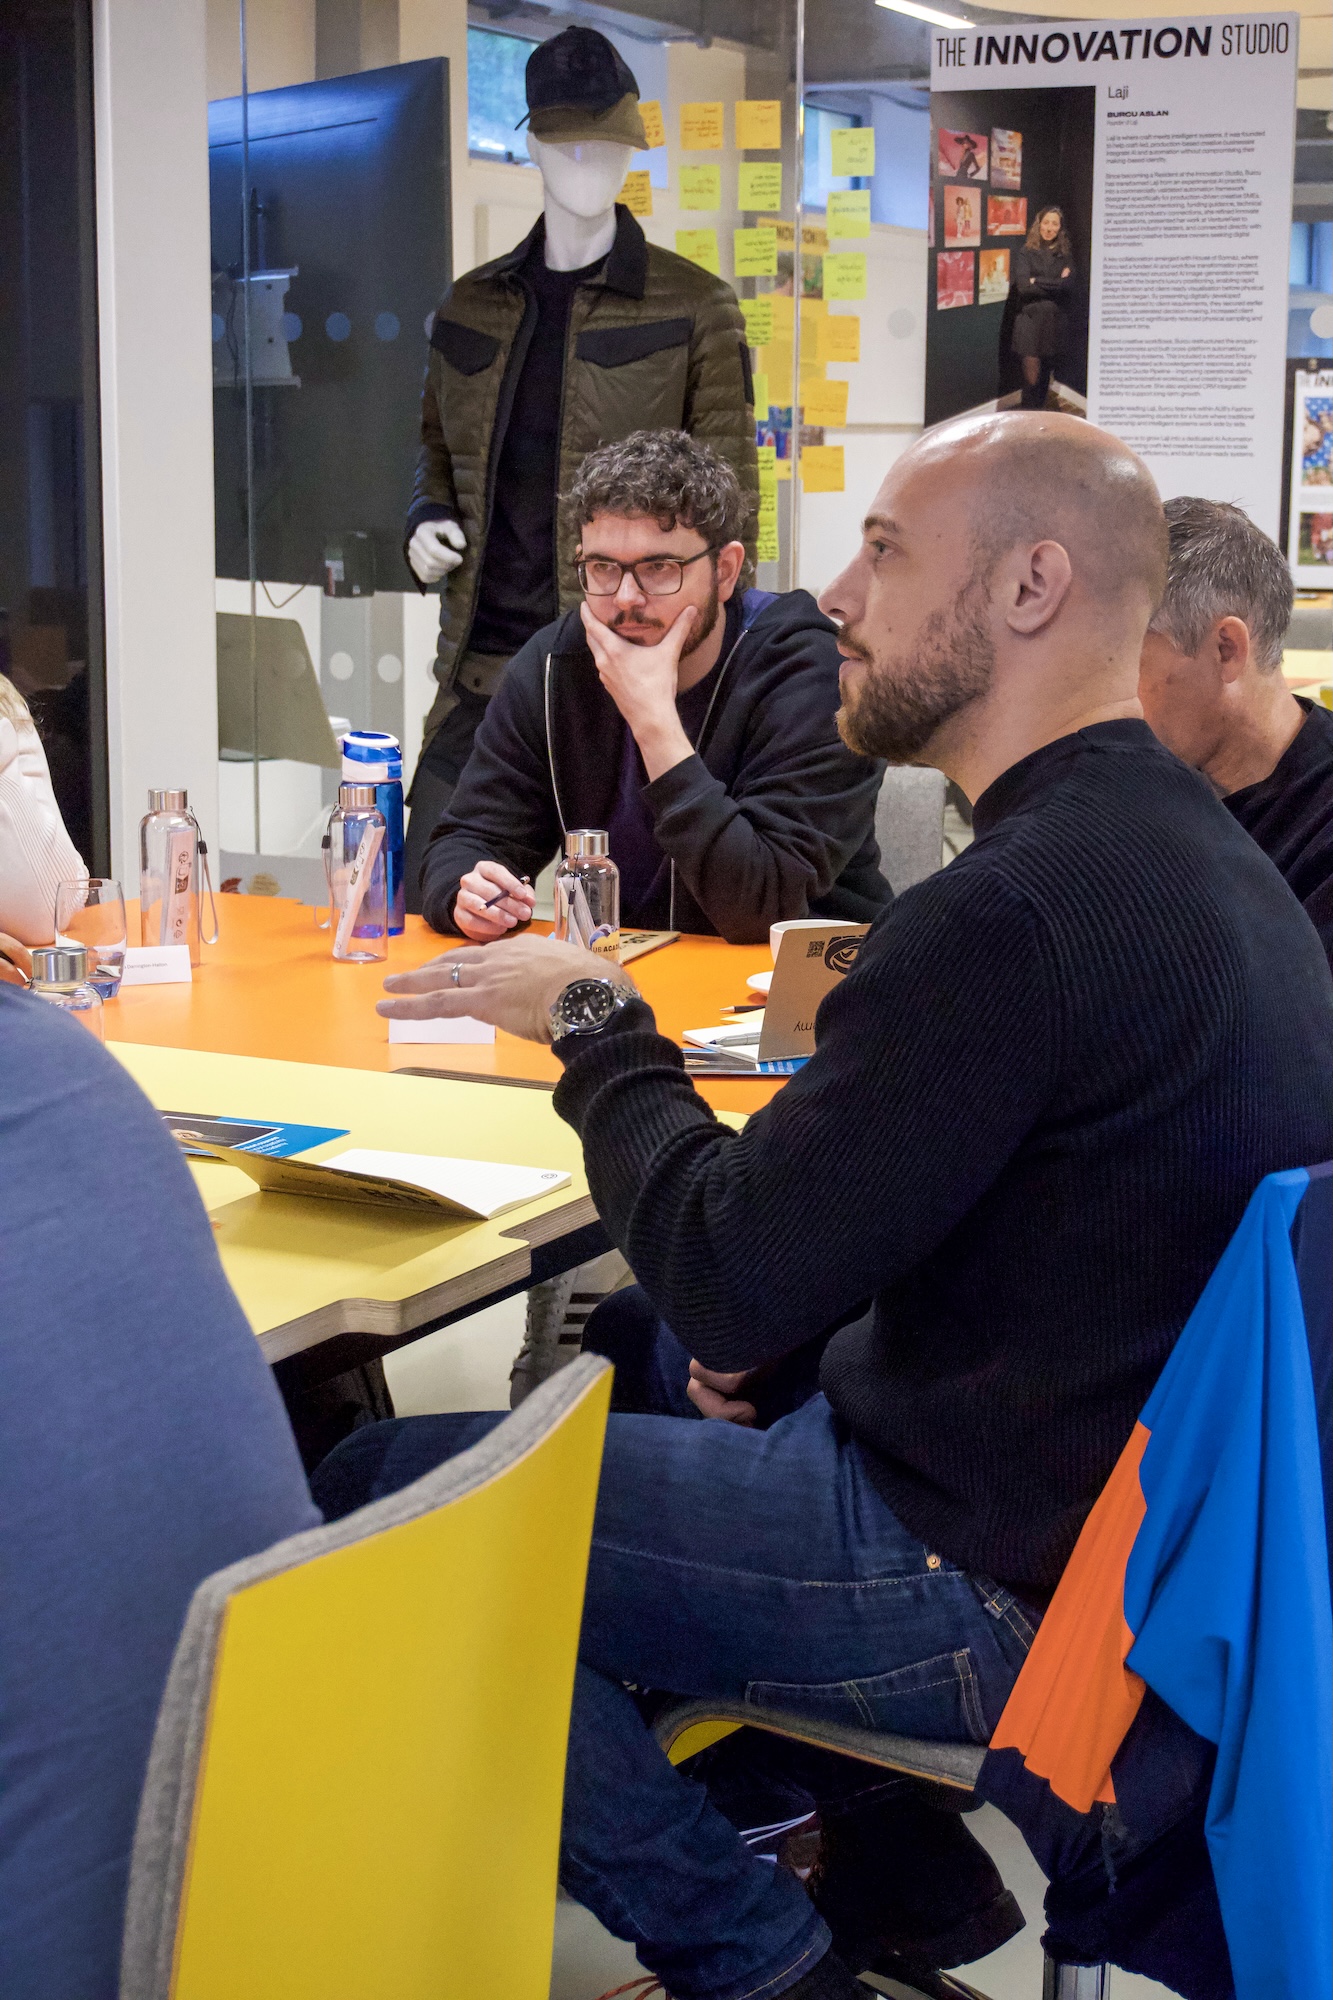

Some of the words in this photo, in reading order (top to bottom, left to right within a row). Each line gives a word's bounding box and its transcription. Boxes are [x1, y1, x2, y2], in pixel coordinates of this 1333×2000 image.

[936, 37, 966, 67] THE
[973, 25, 1213, 66] INNOVATION
[1221, 22, 1289, 56] STUDIO
[1107, 85, 1129, 101] Laji
[793, 1020, 815, 1032] my
